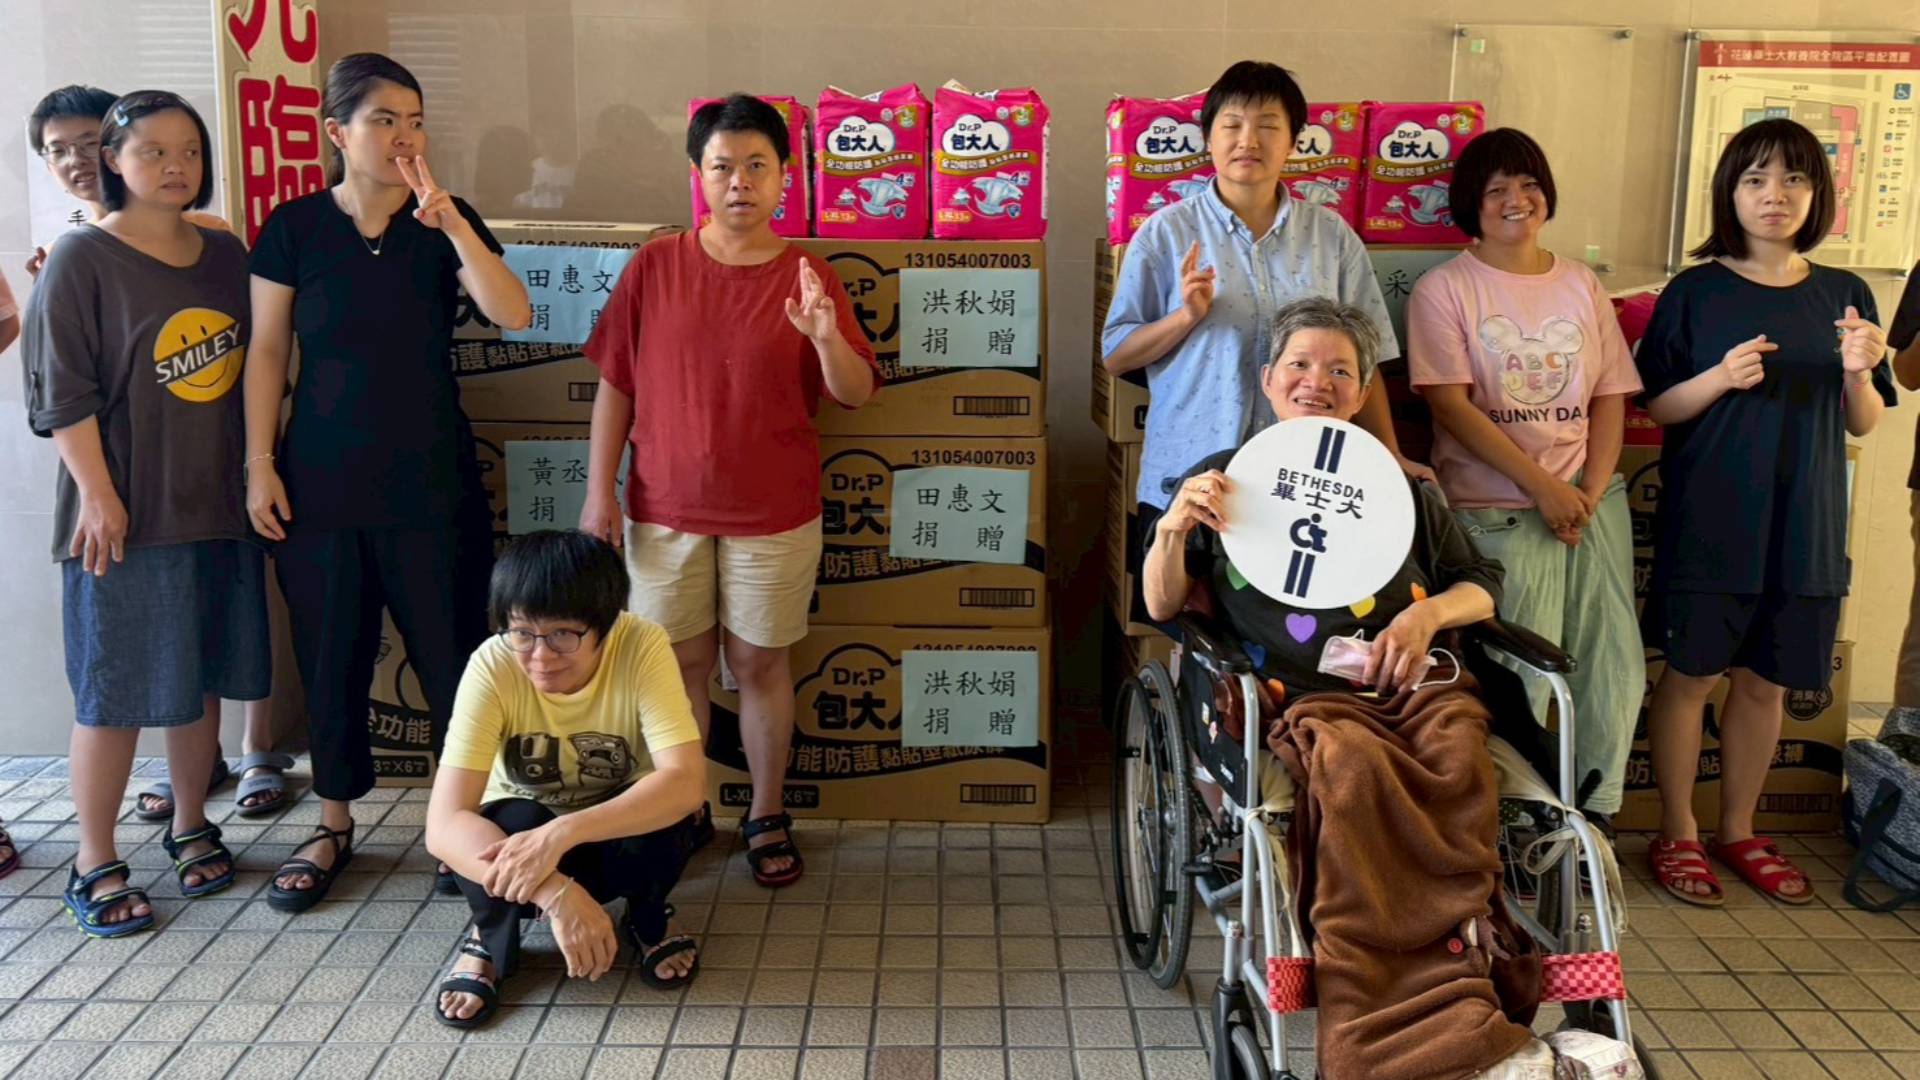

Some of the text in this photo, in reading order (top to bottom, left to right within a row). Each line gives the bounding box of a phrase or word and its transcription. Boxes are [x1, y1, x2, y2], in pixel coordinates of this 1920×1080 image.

[1153, 126, 1177, 135] Dr.P
[1398, 130, 1421, 139] Dr.P
[836, 135, 885, 152] 包大人
[951, 133, 1000, 151] 包大人
[1144, 136, 1196, 154] 包大人
[1388, 141, 1439, 158] 包大人
[904, 253, 1032, 268] 131054007003
[526, 264, 614, 294] 田惠文
[922, 288, 1016, 317] 洪秋娟
[156, 322, 242, 384] SMILEY
[1489, 406, 1590, 424] SUNNY DA
[911, 449, 1036, 465] 131054007003
[831, 473, 884, 492] Dr.P
[1277, 467, 1365, 501] BETHESDA
[917, 483, 1006, 513] 田惠文
[1270, 481, 1363, 520] 畢士大
[831, 668, 886, 687] Dr.P
[924, 670, 1016, 698] 洪秋娟
